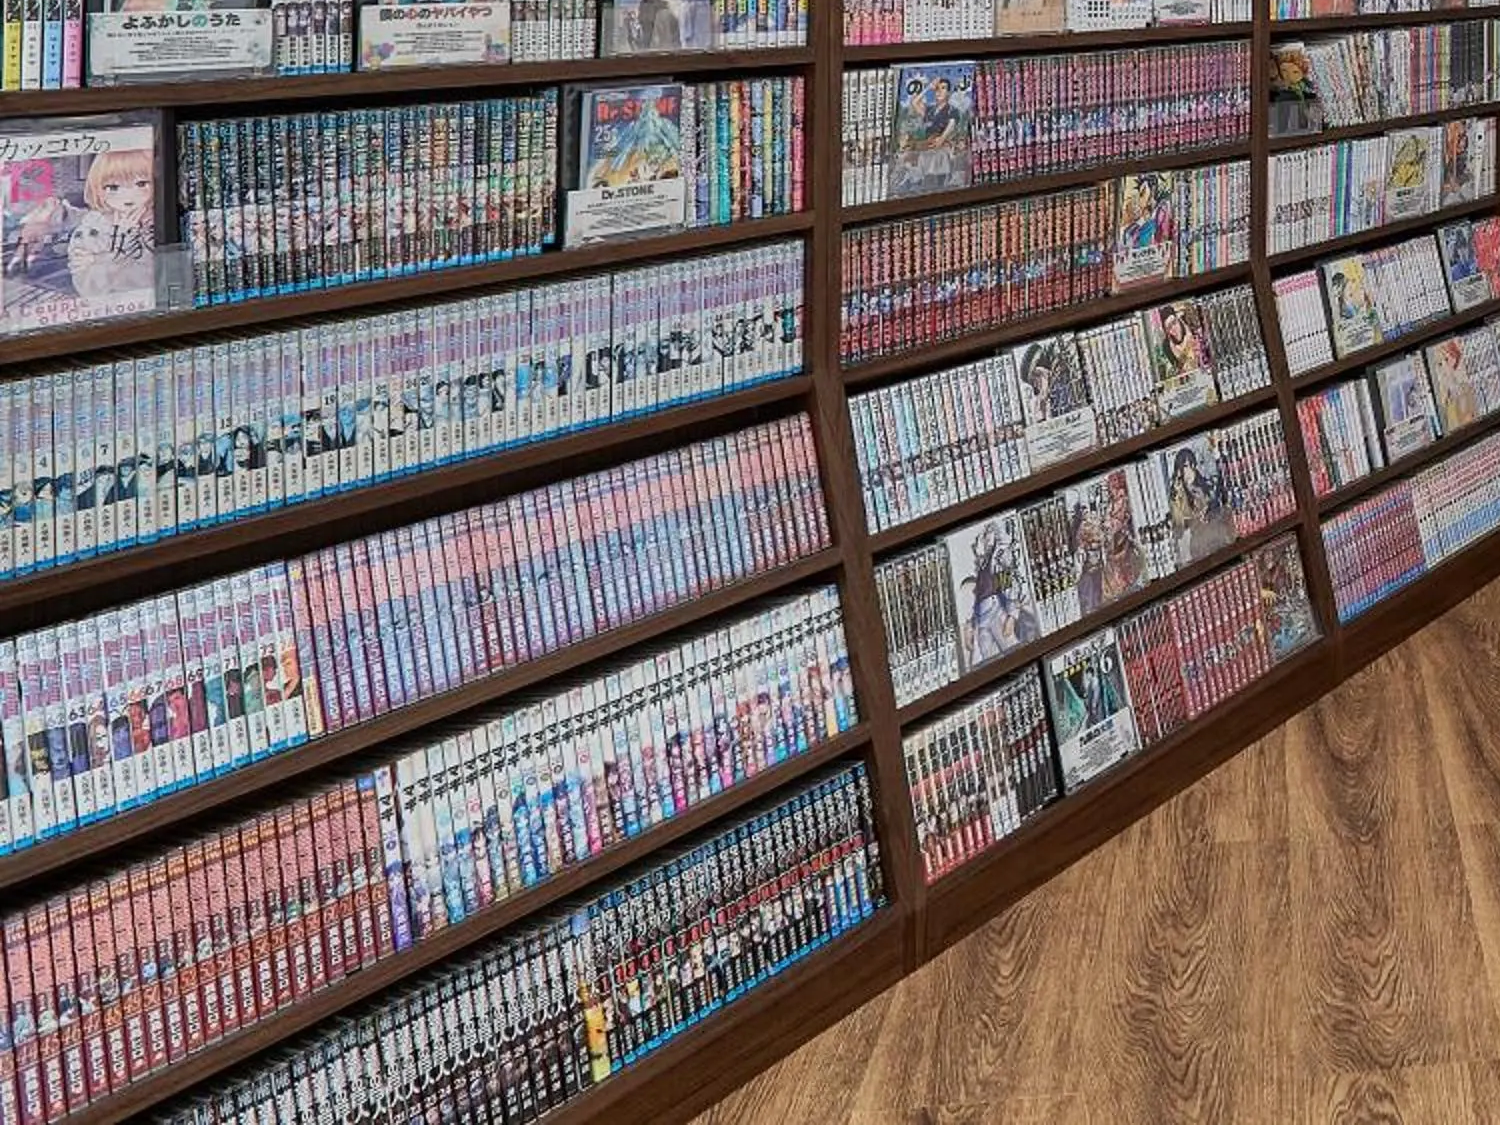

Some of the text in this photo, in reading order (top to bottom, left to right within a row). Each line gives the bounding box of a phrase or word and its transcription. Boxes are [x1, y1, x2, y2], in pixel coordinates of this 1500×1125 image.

[122, 13, 240, 29] よふかしのうた
[0, 134, 111, 160] カッコウの
[601, 184, 654, 200] Dr.STONE
[146, 680, 162, 695] 67
[109, 692, 127, 709] 65
[69, 705, 85, 721] 63
